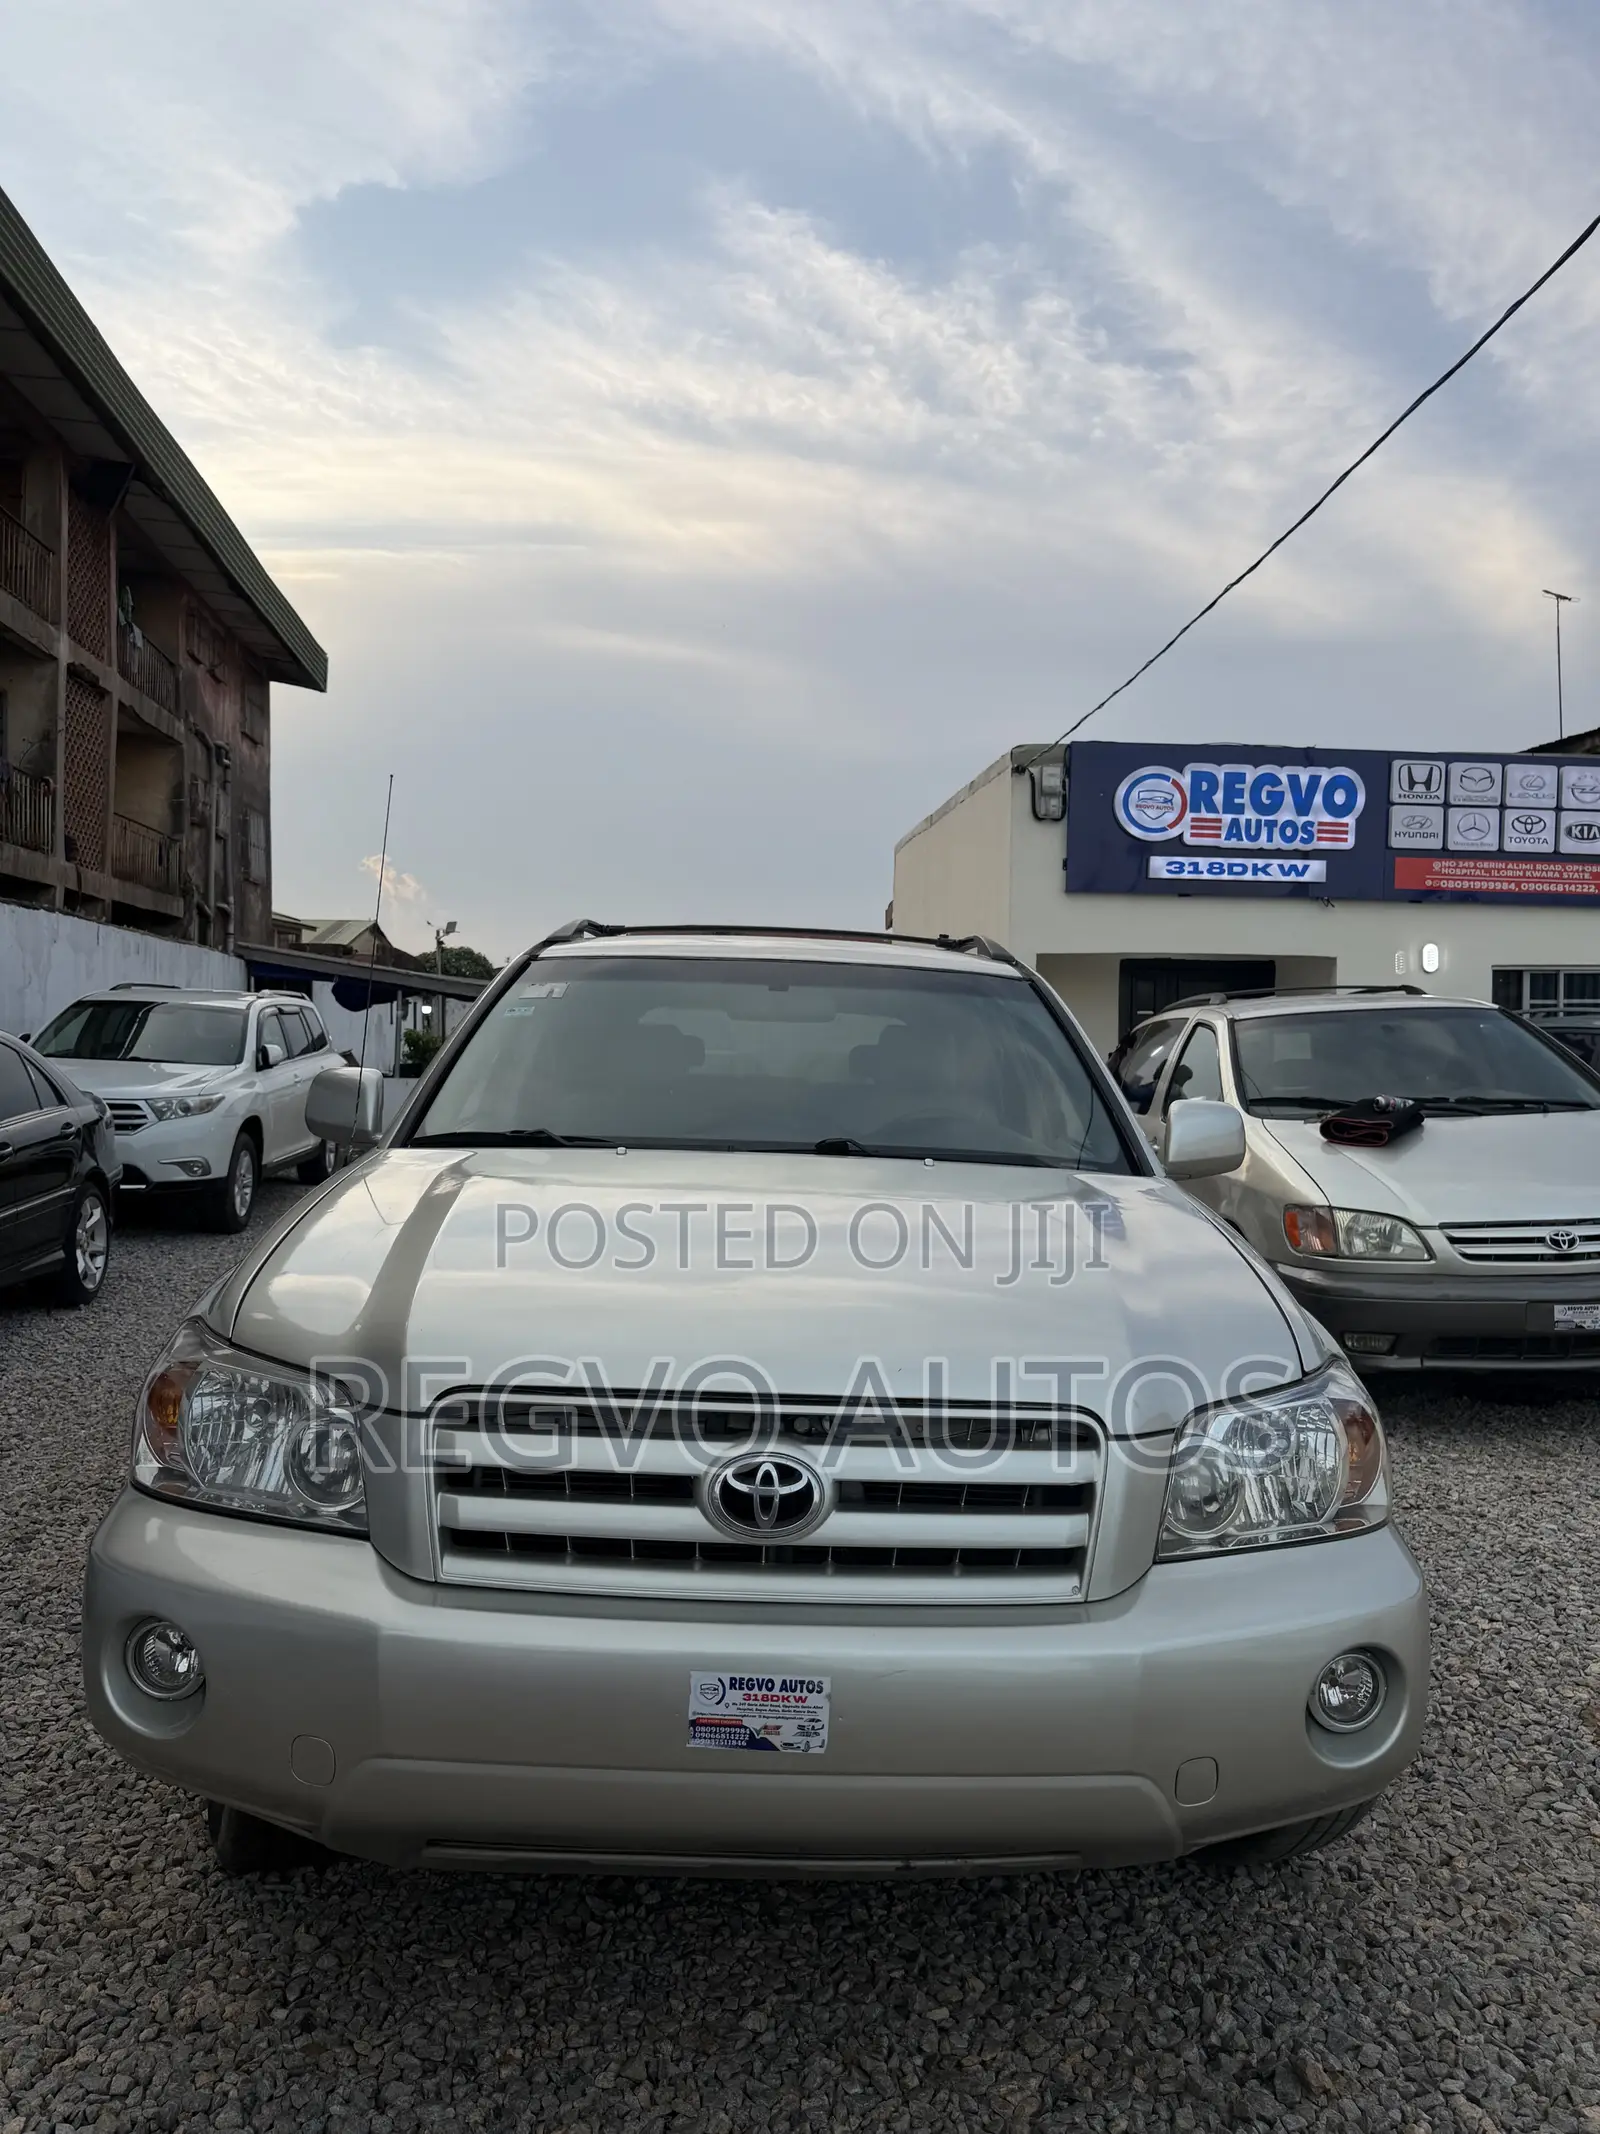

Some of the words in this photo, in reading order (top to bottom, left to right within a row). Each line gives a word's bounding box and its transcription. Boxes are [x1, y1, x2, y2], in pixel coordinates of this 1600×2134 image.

[1189, 769, 1359, 818] REGVO
[1224, 818, 1316, 844] AUTOS
[1394, 831, 1439, 839] HYUNDAI
[1571, 826, 1600, 839] KIA
[1508, 836, 1549, 845] TOYOTA
[1165, 860, 1311, 877] 318DKW
[1476, 861, 1505, 869] GERIN
[1507, 862, 1534, 870] ALIMI
[1491, 869, 1524, 877] ILORIN
[1526, 870, 1560, 878] KWARA
[729, 1676, 775, 1692] REGVO
[779, 1678, 824, 1694] AUTOS
[742, 1693, 809, 1704] 318DKW
[695, 1726, 750, 1734] 08091999984
[695, 1732, 750, 1740] 09066814222
